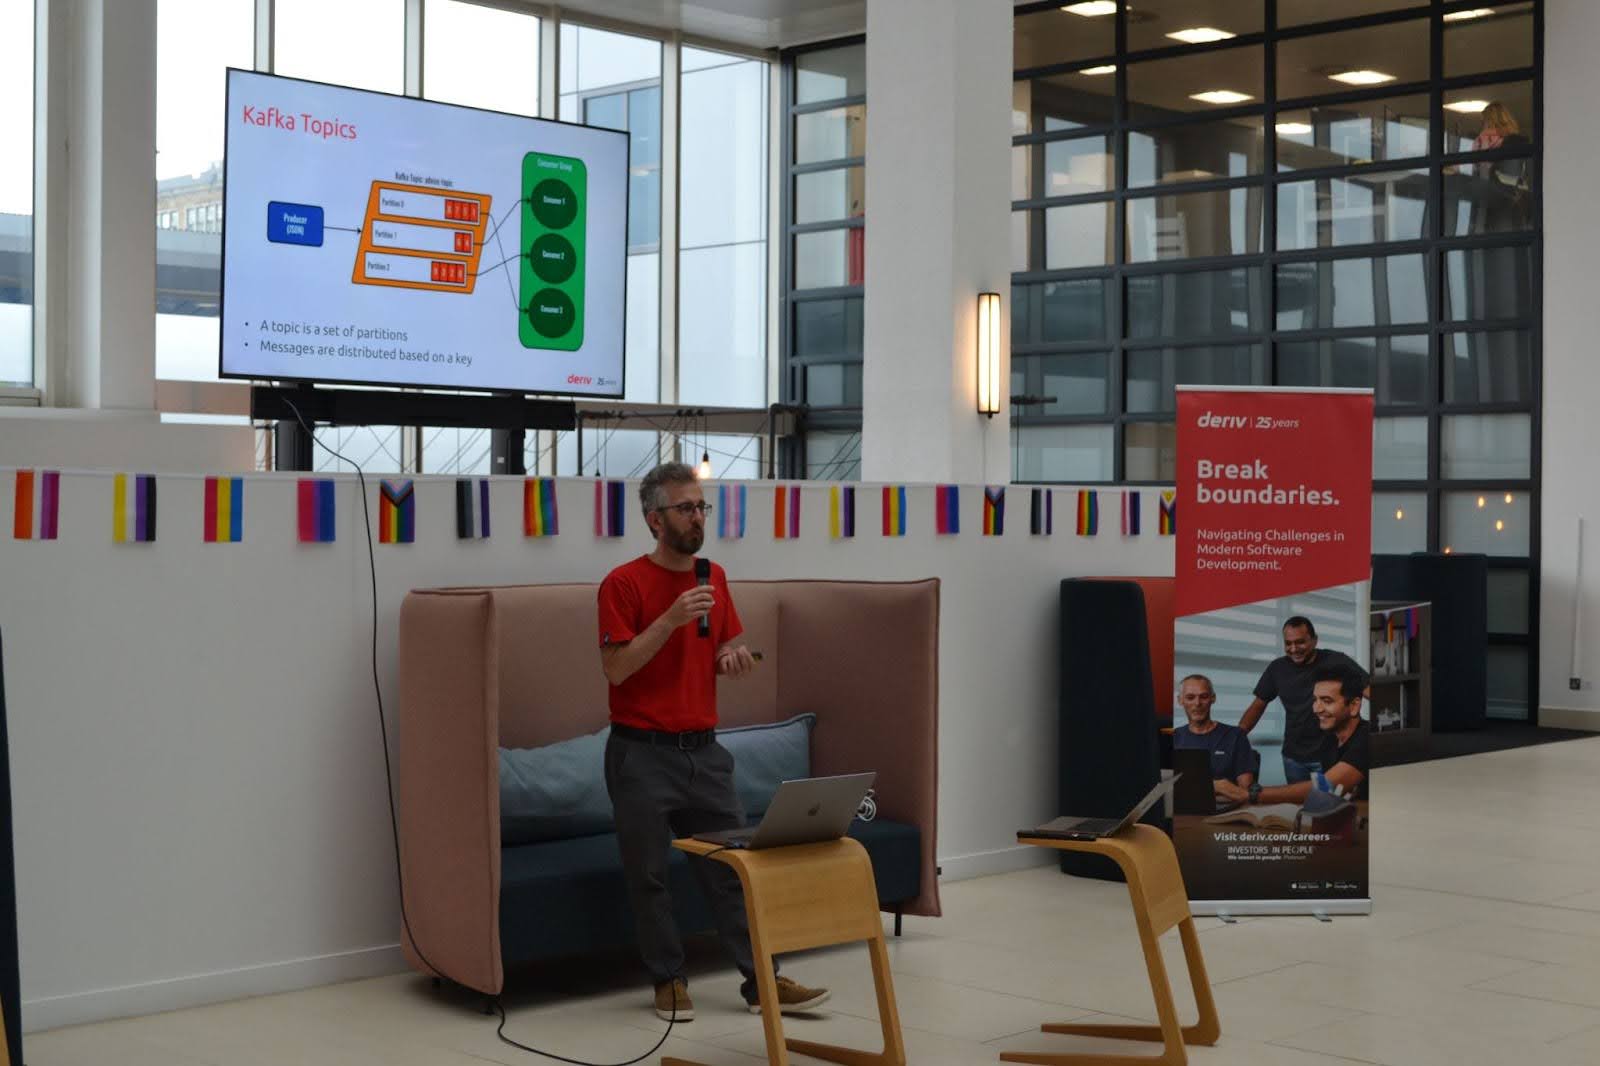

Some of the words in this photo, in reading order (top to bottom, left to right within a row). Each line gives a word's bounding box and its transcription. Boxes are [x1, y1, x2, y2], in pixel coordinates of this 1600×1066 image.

[243, 105, 295, 131] Kafka
[301, 113, 357, 139] Topics
[382, 198, 400, 208] Partition
[283, 213, 307, 225] Producer
[375, 230, 393, 240] Partition
[367, 261, 386, 271] Partition
[260, 320, 269, 331] A
[271, 321, 299, 335] topic
[303, 322, 314, 334] is
[314, 326, 320, 335] a
[323, 324, 339, 337] set
[343, 326, 354, 337] of
[357, 327, 408, 342] partitions
[260, 340, 315, 356] Messages
[317, 345, 335, 356] are
[337, 345, 397, 360] distributed
[399, 350, 429, 362] based
[432, 353, 445, 363] on
[447, 355, 453, 364] a
[456, 352, 473, 367] key
[567, 374, 592, 385] deriv
[1197, 411, 1247, 429] deriv
[1255, 416, 1272, 429] 25
[1272, 419, 1299, 430] years
[1197, 459, 1268, 480] Break
[1197, 482, 1340, 505] boundaries.
[1197, 529, 1262, 542] Navigating
[1265, 529, 1331, 543] Challenges
[1334, 532, 1345, 542] in
[1197, 543, 1244, 555] Modern
[1247, 544, 1303, 556] Software
[1197, 558, 1281, 572] Development.
[1214, 832, 1237, 842] Visit
[1239, 832, 1330, 843] deriv.com/careers
[1227, 845, 1269, 854] INVESTORS
[1272, 845, 1280, 854] IN
